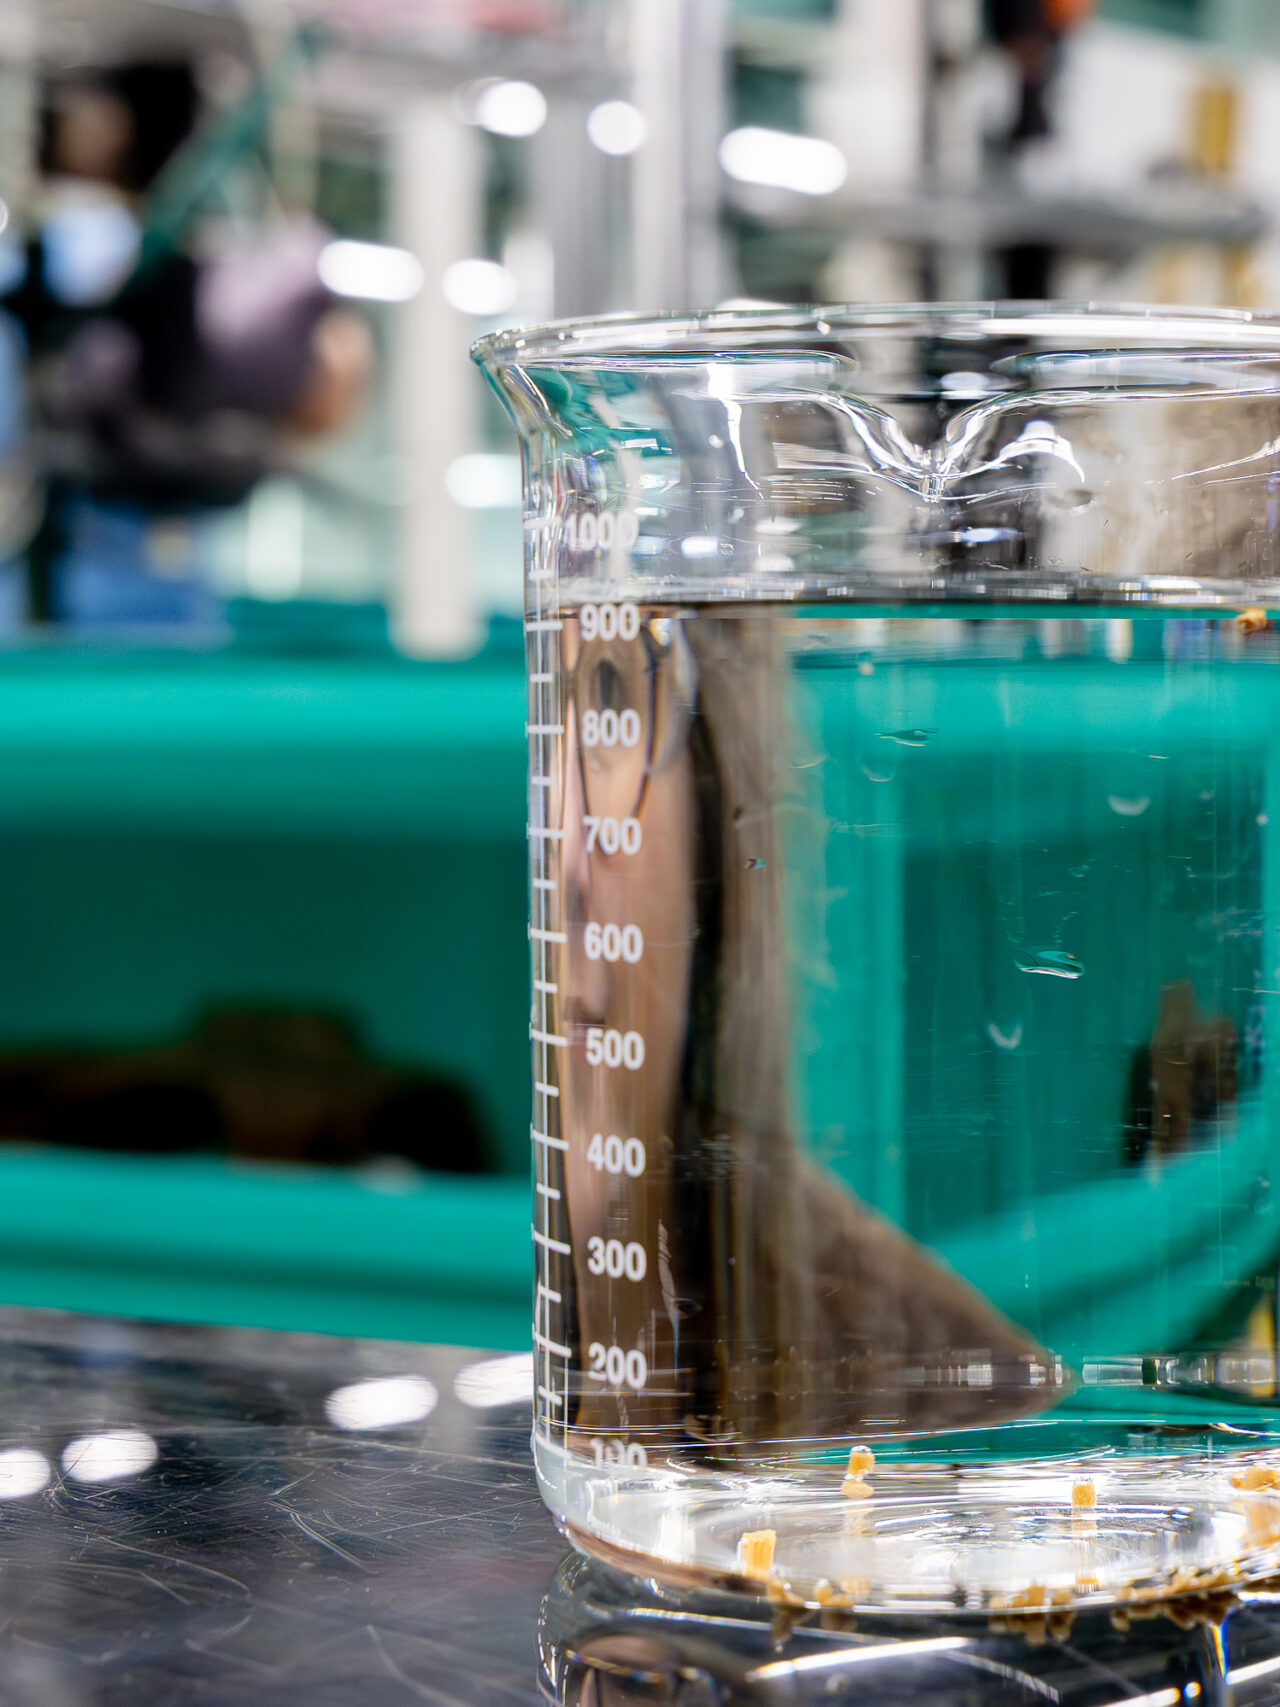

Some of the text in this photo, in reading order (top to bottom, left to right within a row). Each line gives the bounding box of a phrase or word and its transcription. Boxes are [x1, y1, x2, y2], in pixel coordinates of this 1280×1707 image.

[564, 511, 640, 551] 1000
[580, 603, 640, 640] 900
[582, 709, 641, 747] 800
[584, 817, 642, 855] 700
[584, 923, 643, 964] 600
[585, 1028, 645, 1070] 500
[586, 1133, 646, 1178] 400
[587, 1236, 647, 1282] 300
[588, 1342, 648, 1389] 200
